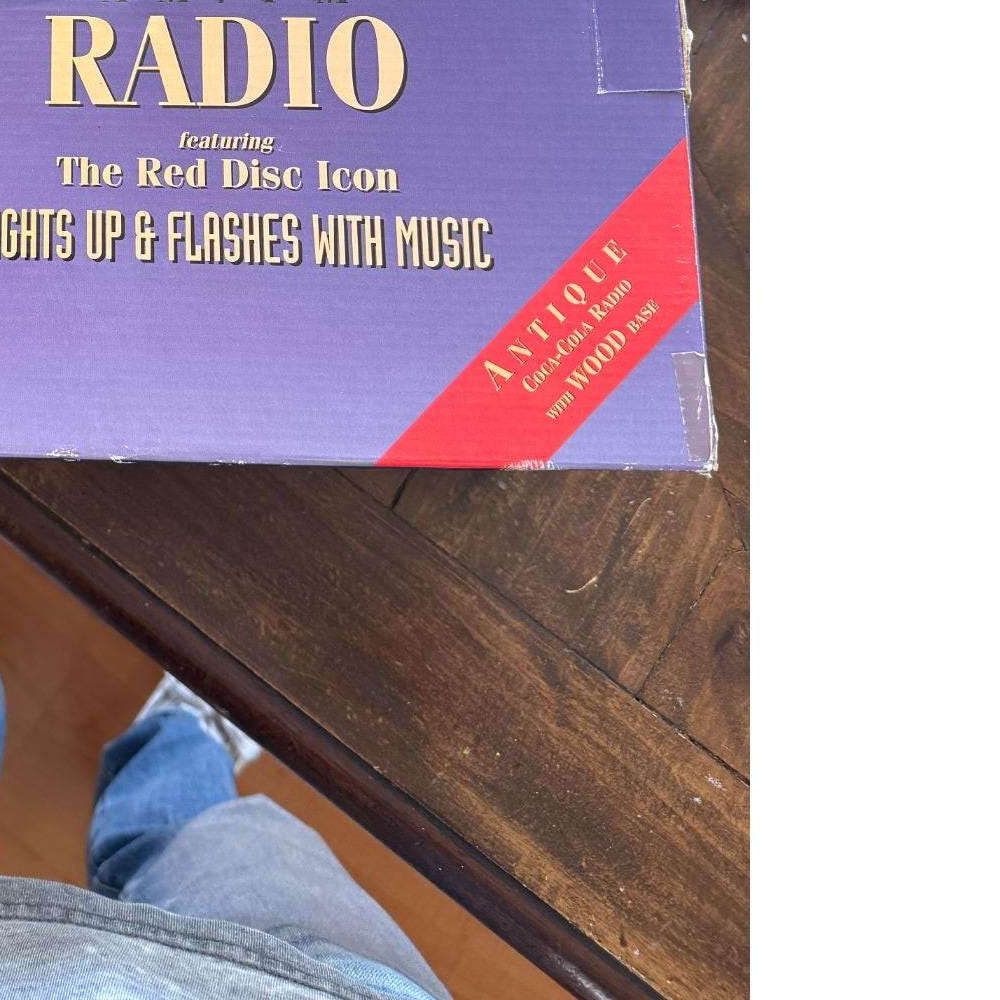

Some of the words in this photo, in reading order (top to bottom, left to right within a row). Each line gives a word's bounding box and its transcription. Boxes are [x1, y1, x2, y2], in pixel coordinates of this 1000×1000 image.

[44, 14, 408, 112] RADIO
[56, 156, 124, 188] The
[136, 157, 208, 189] Red
[221, 158, 303, 191] Disc
[316, 160, 401, 193] Icon
[178, 131, 275, 154] featuring
[85, 209, 124, 262] UP
[134, 210, 156, 263] &
[166, 211, 303, 266] FLASHES
[311, 213, 384, 268] WITH
[395, 216, 494, 272] MUSIC
[483, 238, 628, 392] ANTIQUE
[545, 391, 576, 421] WITH
[564, 329, 627, 391] WOOD
[626, 298, 661, 335] BASE
